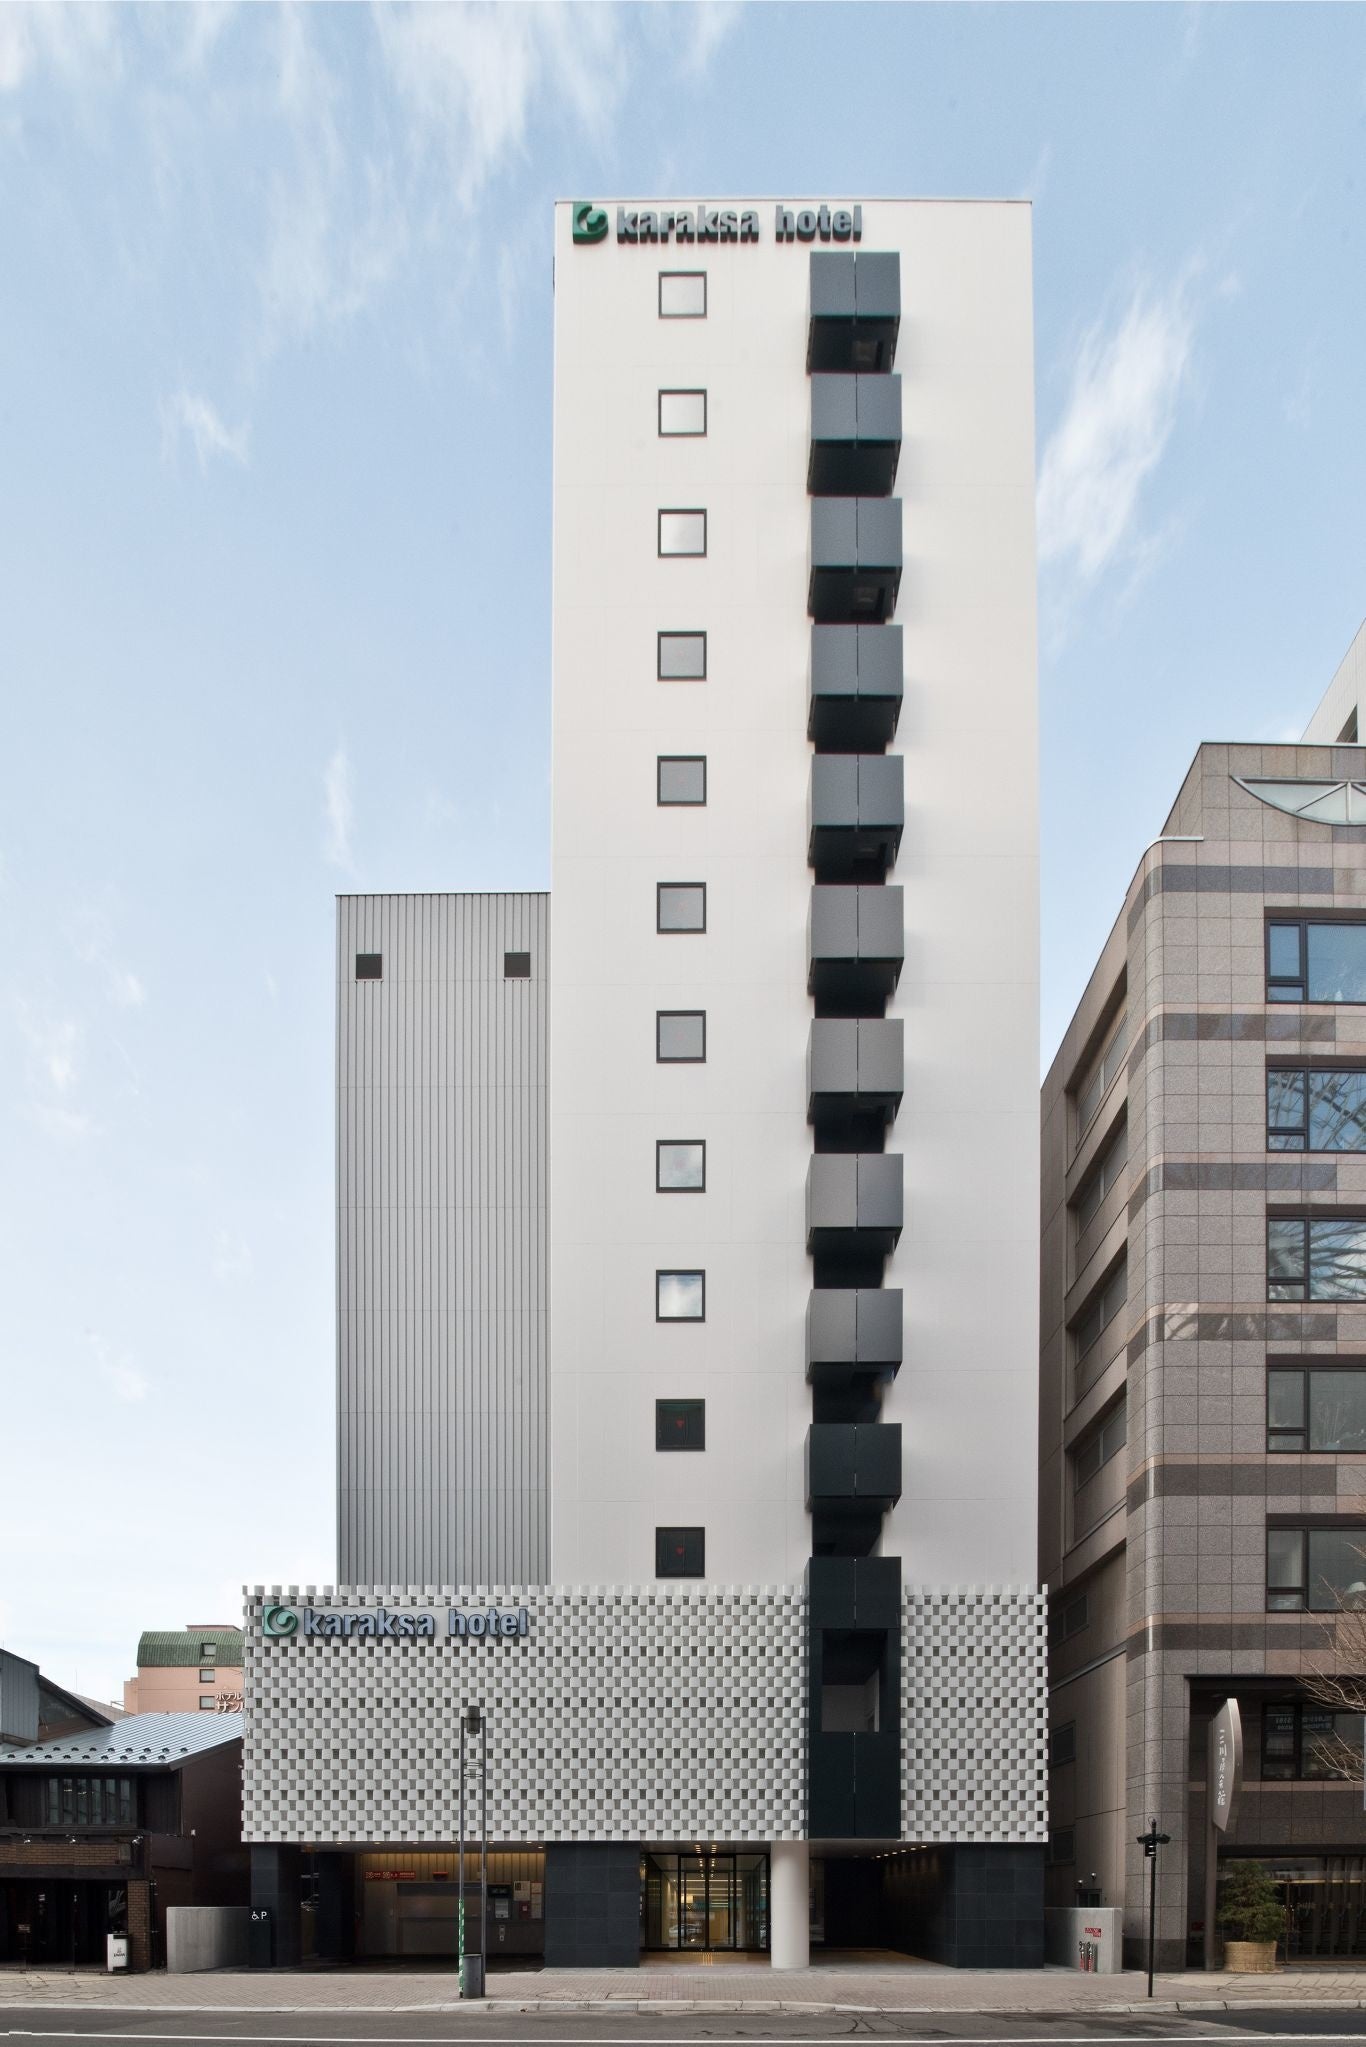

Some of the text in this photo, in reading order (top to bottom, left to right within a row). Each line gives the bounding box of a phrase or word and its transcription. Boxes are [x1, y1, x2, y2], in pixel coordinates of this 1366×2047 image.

[617, 204, 862, 243] karaksa hotel
[303, 1608, 529, 1636] karaksa hotel
[216, 1692, 243, 1701] ホテル
[261, 1911, 267, 1920] P
